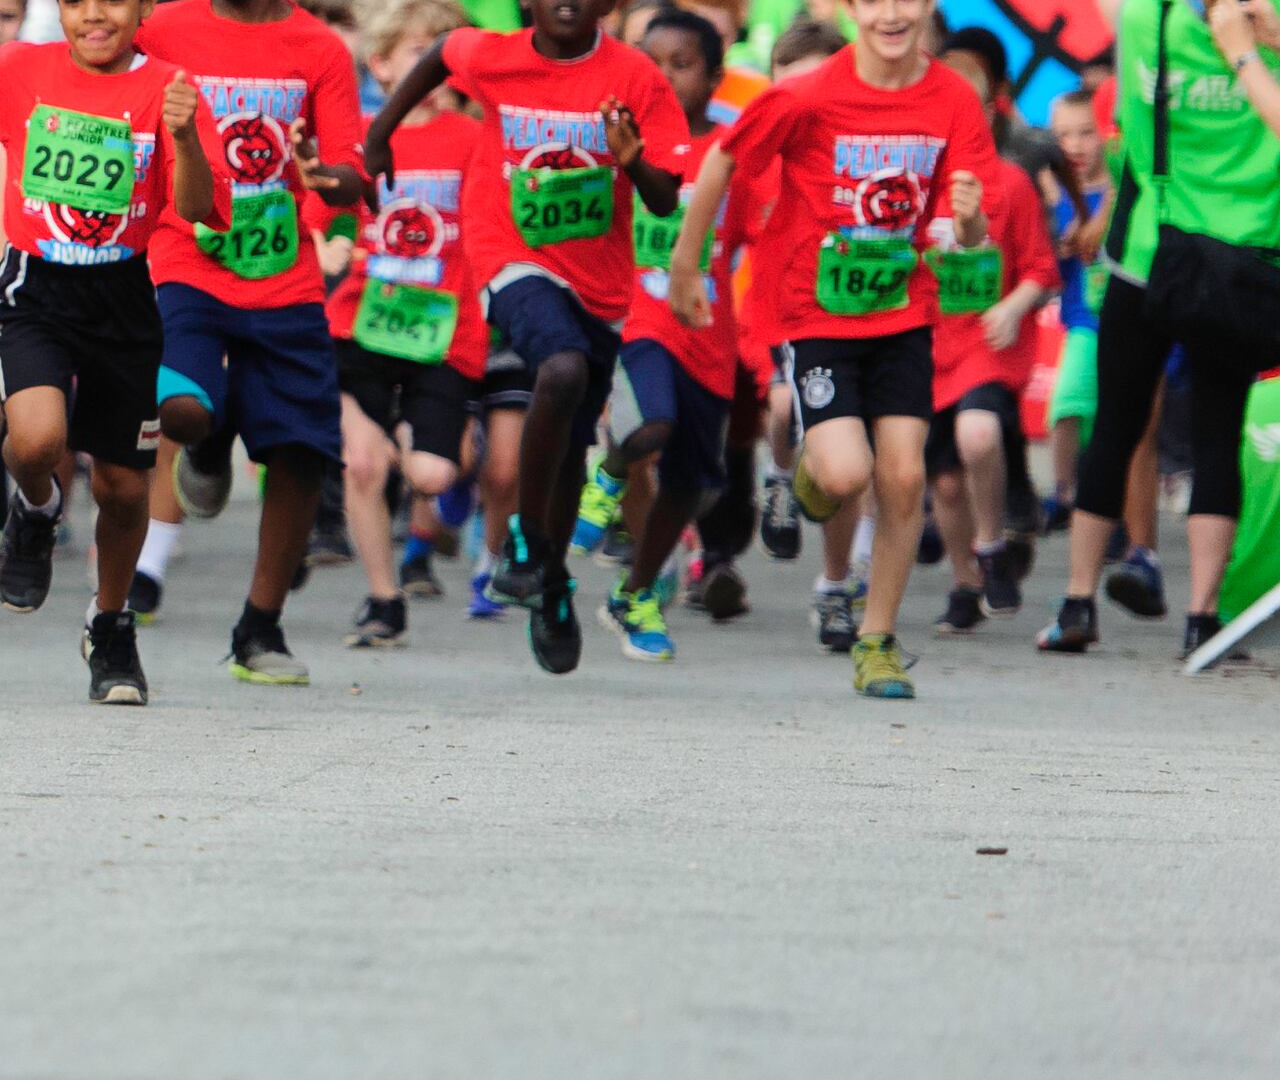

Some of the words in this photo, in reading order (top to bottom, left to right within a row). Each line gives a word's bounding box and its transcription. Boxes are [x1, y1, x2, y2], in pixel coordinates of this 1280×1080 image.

[63, 132, 105, 145] JUNIOR
[67, 119, 131, 141] PEACHTREE
[501, 113, 611, 155] PEACHTRE
[32, 145, 125, 191] 2029
[521, 196, 605, 229] 2034
[209, 224, 289, 261] 2126
